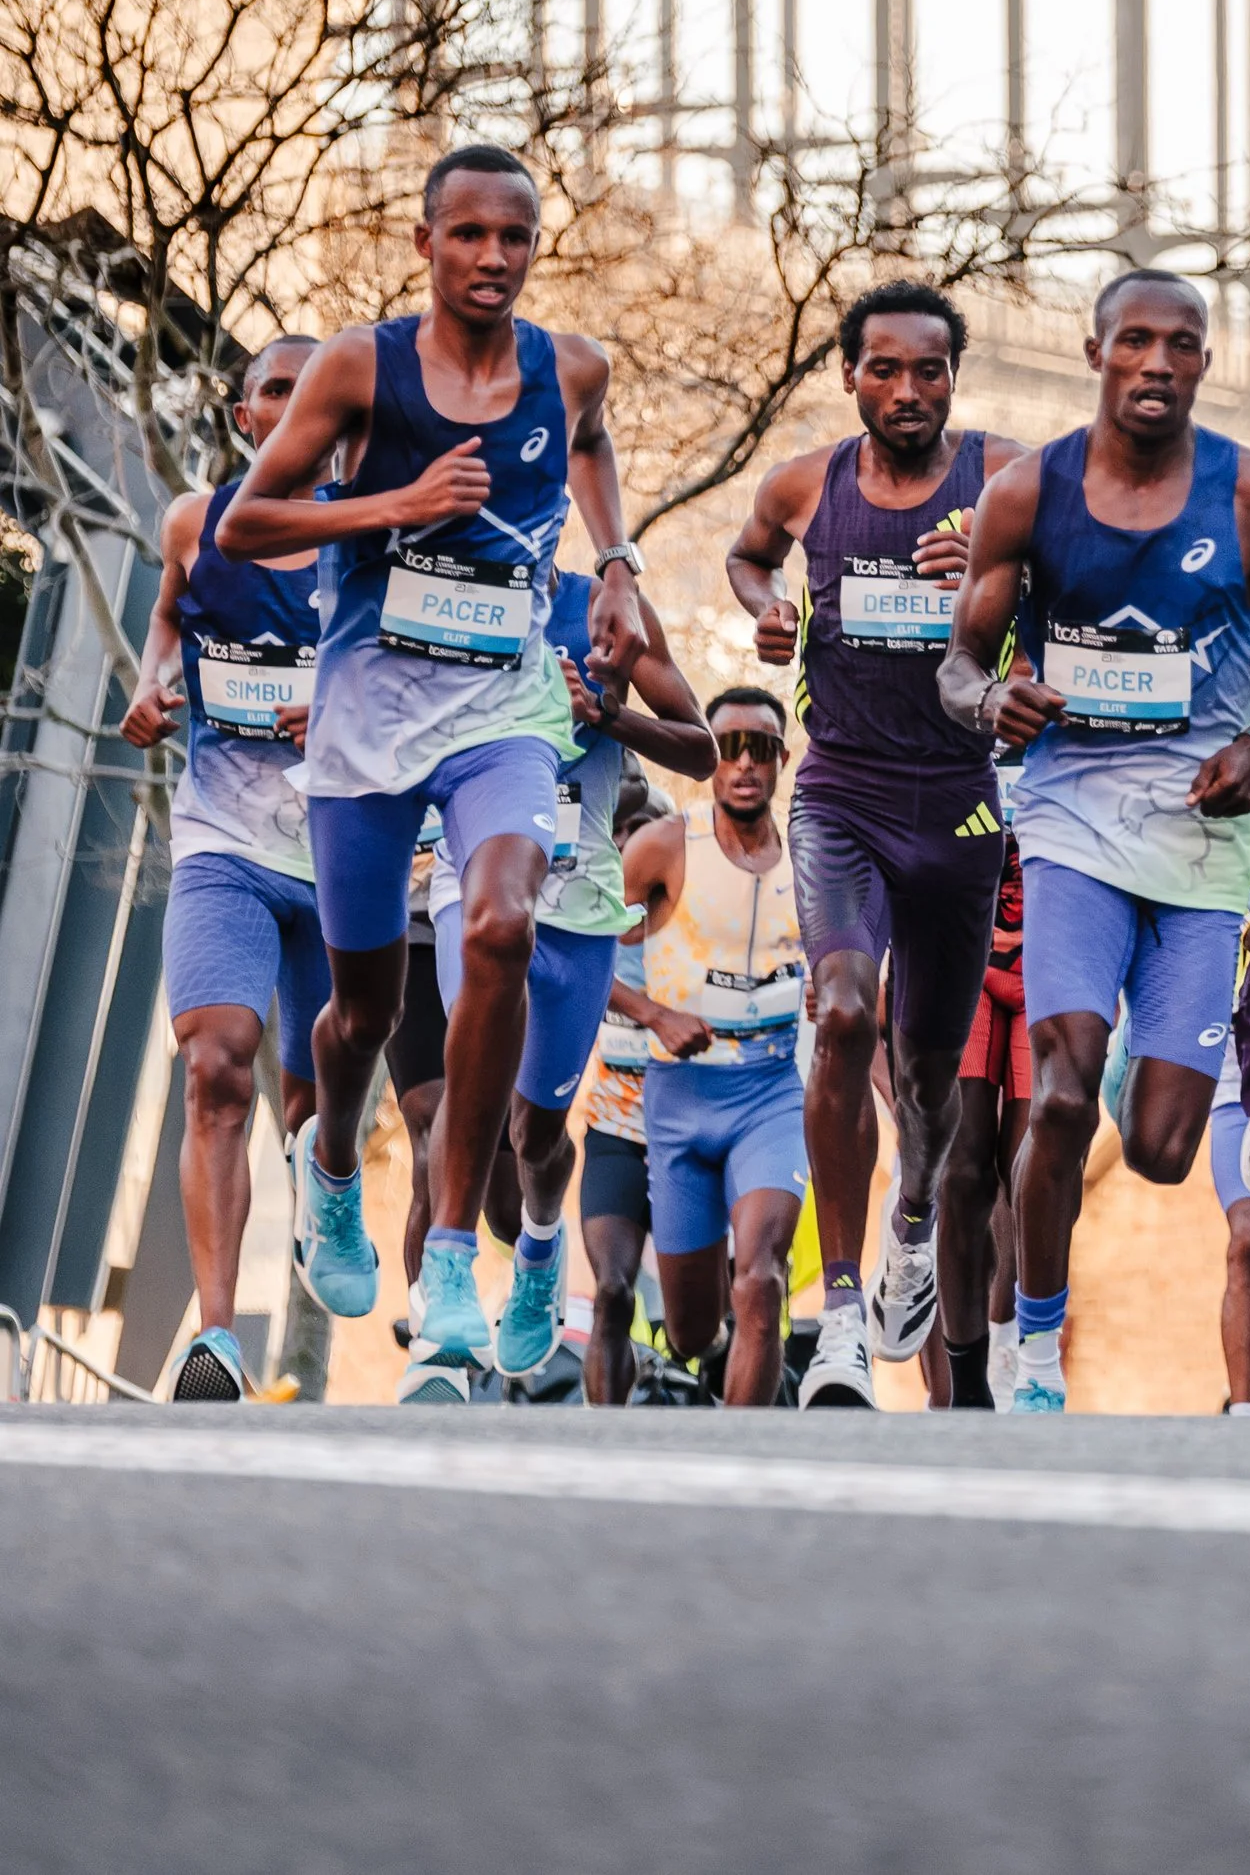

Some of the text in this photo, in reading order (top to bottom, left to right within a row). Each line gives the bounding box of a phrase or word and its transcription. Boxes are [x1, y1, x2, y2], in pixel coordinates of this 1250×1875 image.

[405, 548, 433, 572] tcs
[853, 556, 878, 575] tcs
[421, 593, 505, 626] PACER
[864, 594, 953, 615] DEBELE
[443, 631, 471, 645] ELITE
[1054, 622, 1080, 644] tcs
[208, 639, 229, 660] tcs
[1153, 645, 1179, 654] TATA
[1073, 665, 1154, 693] PACER
[226, 679, 293, 702] SIMBU
[247, 712, 271, 723] ELITE
[1099, 702, 1128, 714] ELITE
